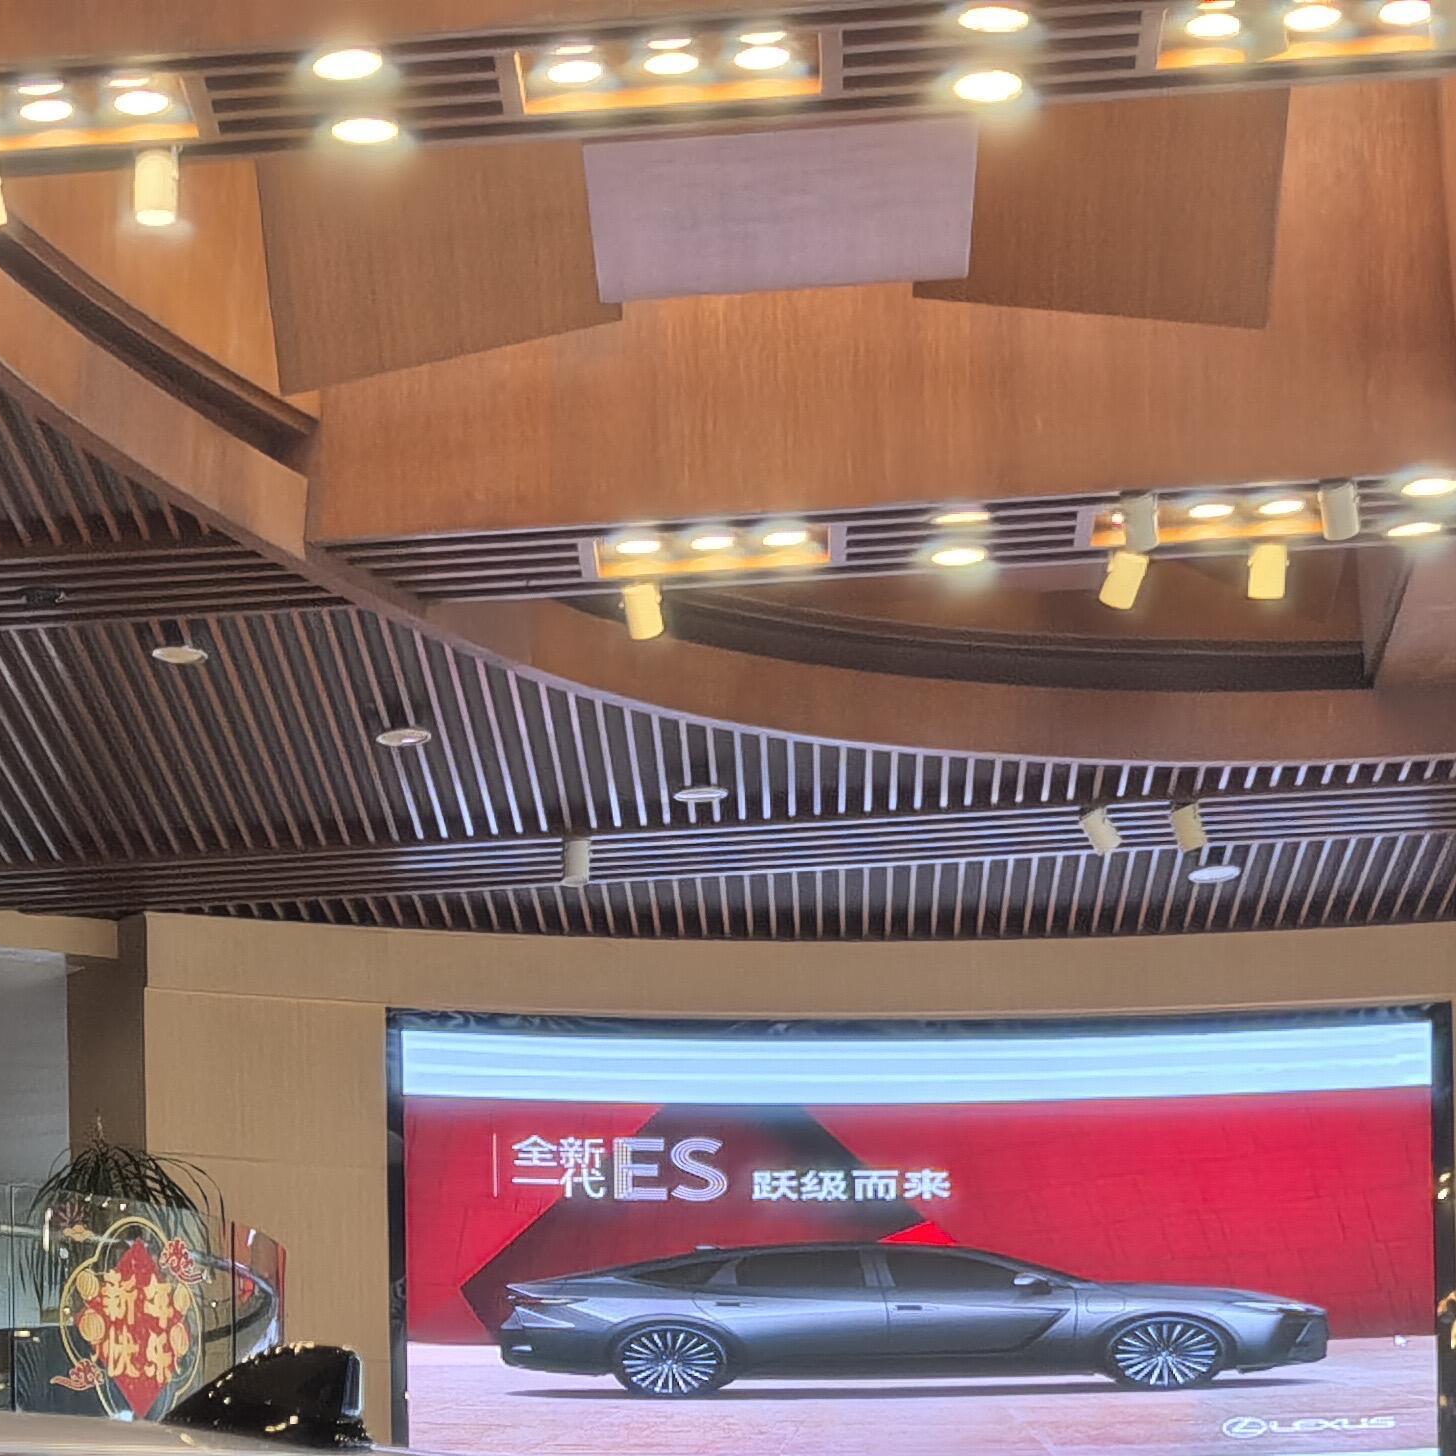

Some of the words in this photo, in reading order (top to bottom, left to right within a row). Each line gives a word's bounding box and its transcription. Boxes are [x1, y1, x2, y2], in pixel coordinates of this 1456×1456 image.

[511, 1135, 605, 1168] 全新
[612, 1137, 728, 1201] ES
[751, 1169, 952, 1201] 跃级而来
[1269, 1416, 1396, 1433] LEXUS
